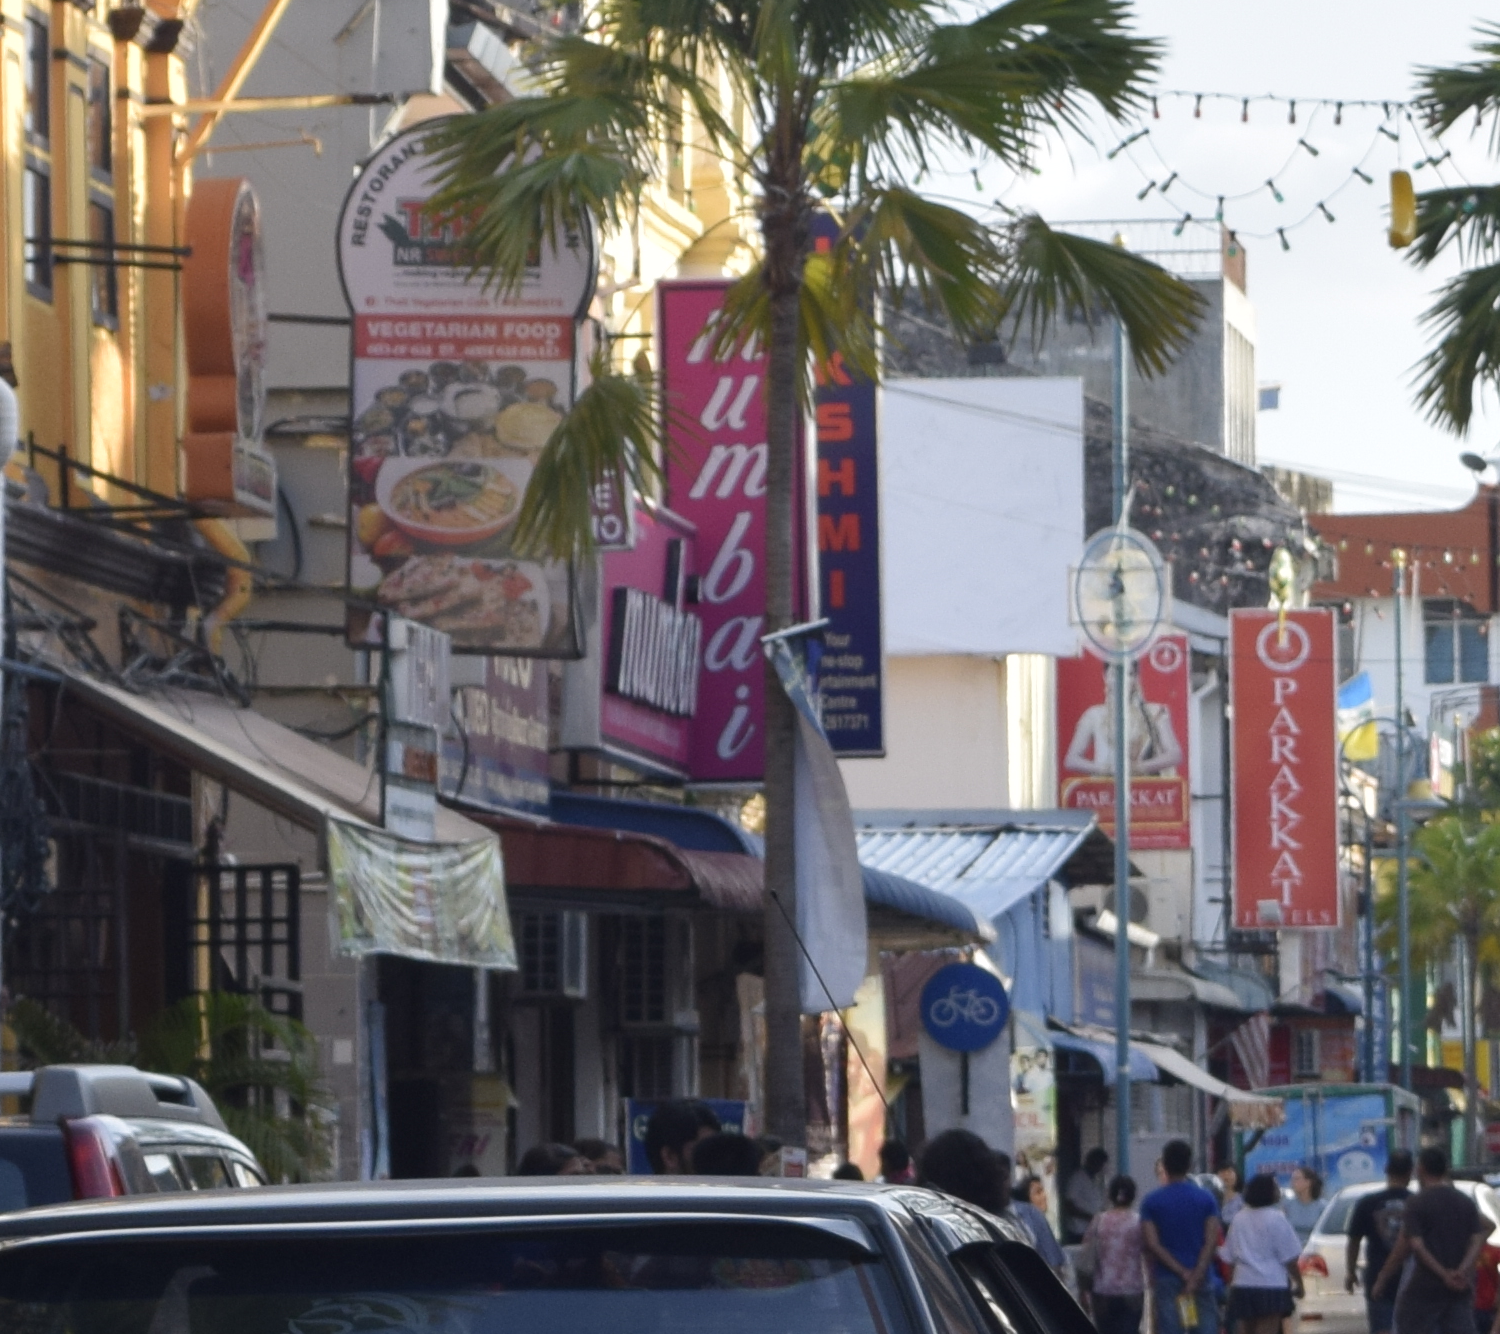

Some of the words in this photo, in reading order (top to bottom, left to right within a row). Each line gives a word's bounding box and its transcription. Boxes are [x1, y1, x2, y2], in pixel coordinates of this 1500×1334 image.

[366, 322, 497, 338] VEGETARIAN
[502, 322, 561, 339] FOOD
[820, 654, 864, 671] ne-stop
[1076, 788, 1178, 806] PARKKAT
[1268, 676, 1303, 907] PARAKKAT
[1243, 909, 1331, 924] JELS
